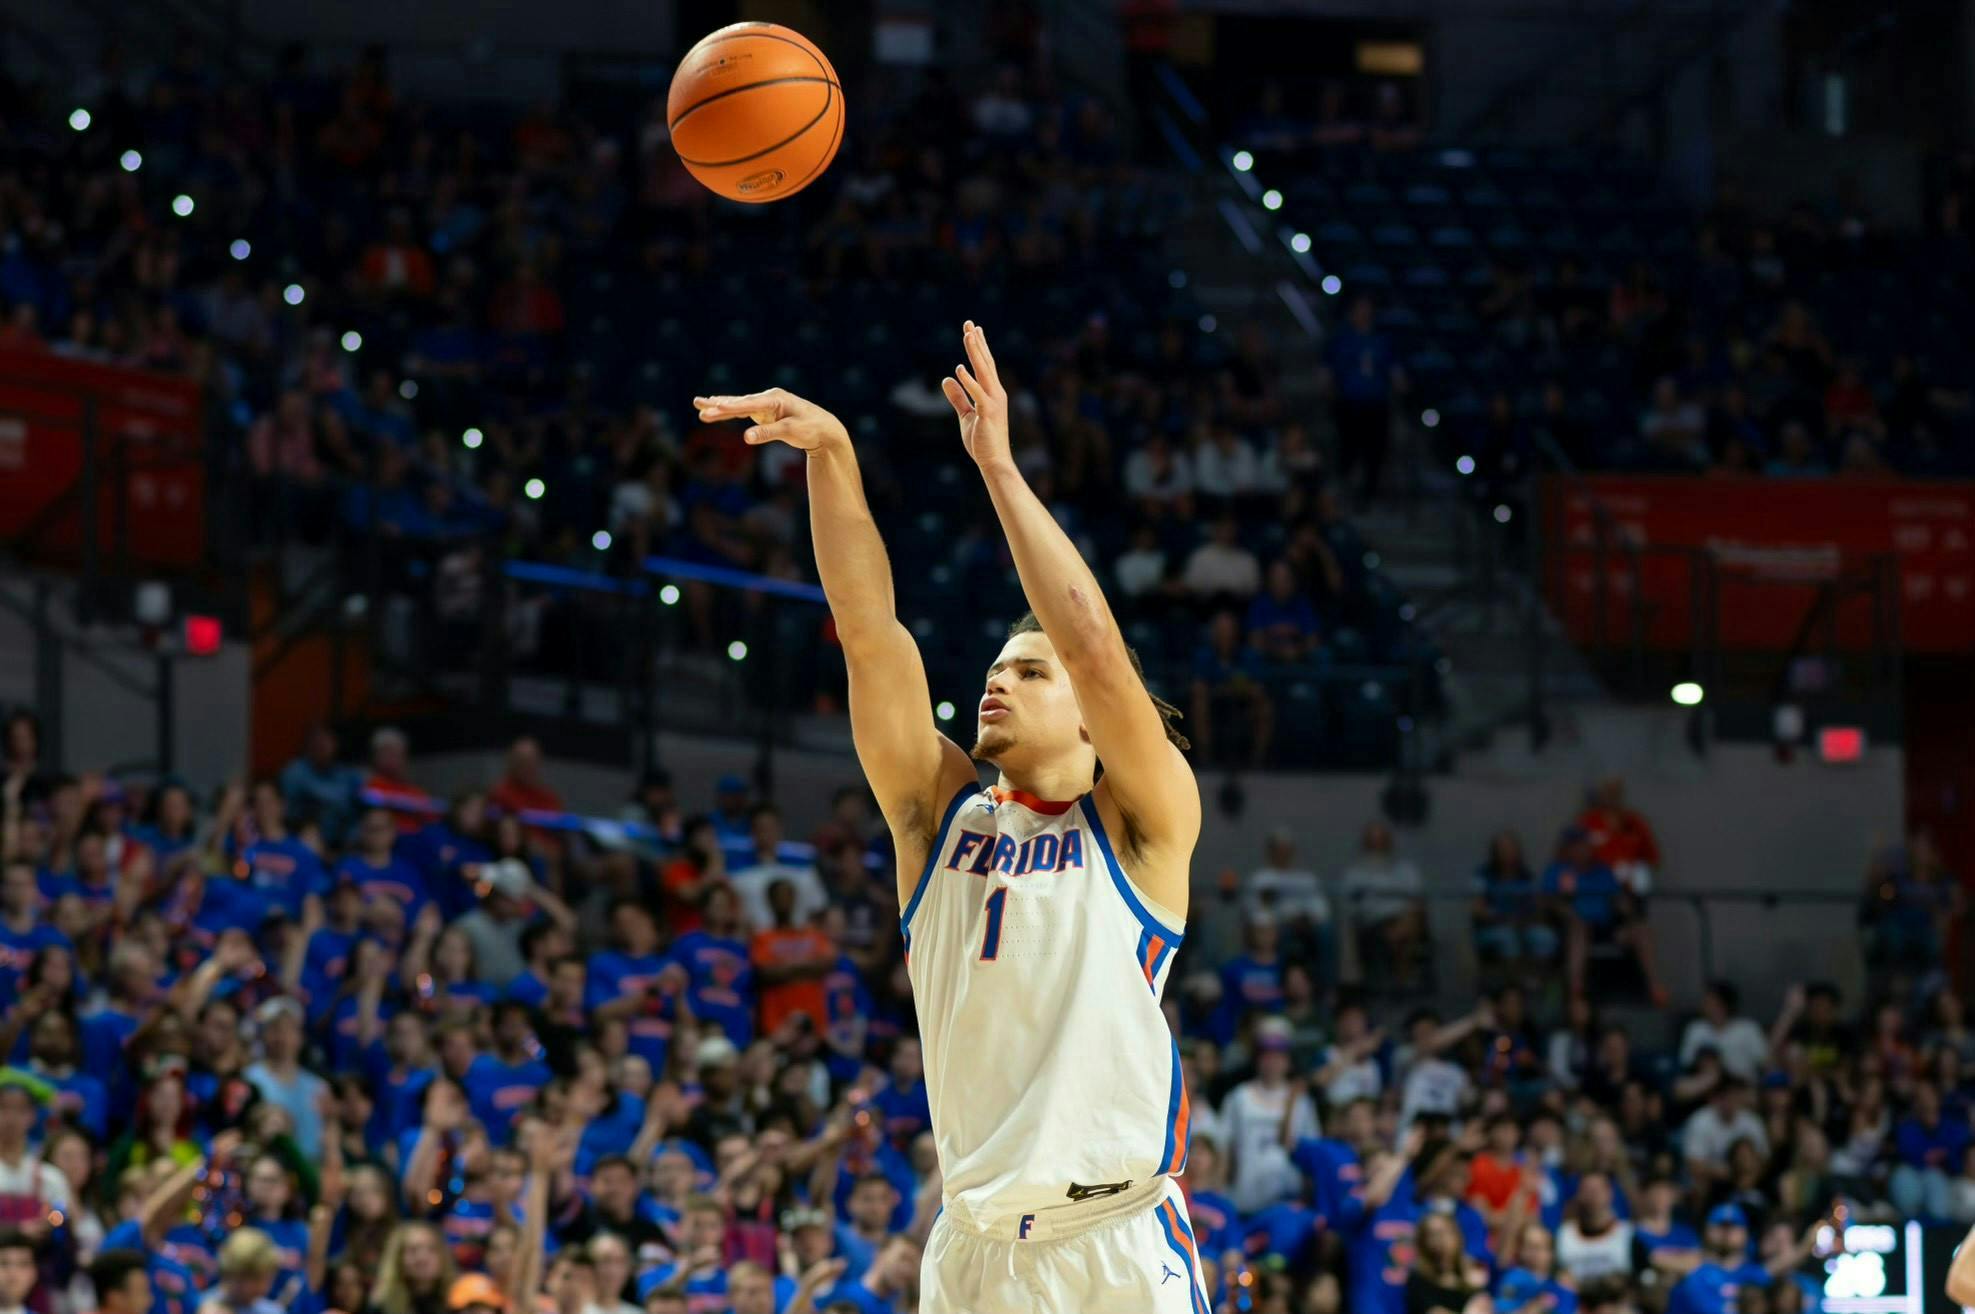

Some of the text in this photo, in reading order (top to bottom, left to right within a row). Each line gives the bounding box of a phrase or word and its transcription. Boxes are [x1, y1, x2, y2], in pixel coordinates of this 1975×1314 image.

[944, 828, 1084, 877] FLRIDA
[979, 886, 1008, 961] 1
[1018, 1214, 1036, 1240] F
